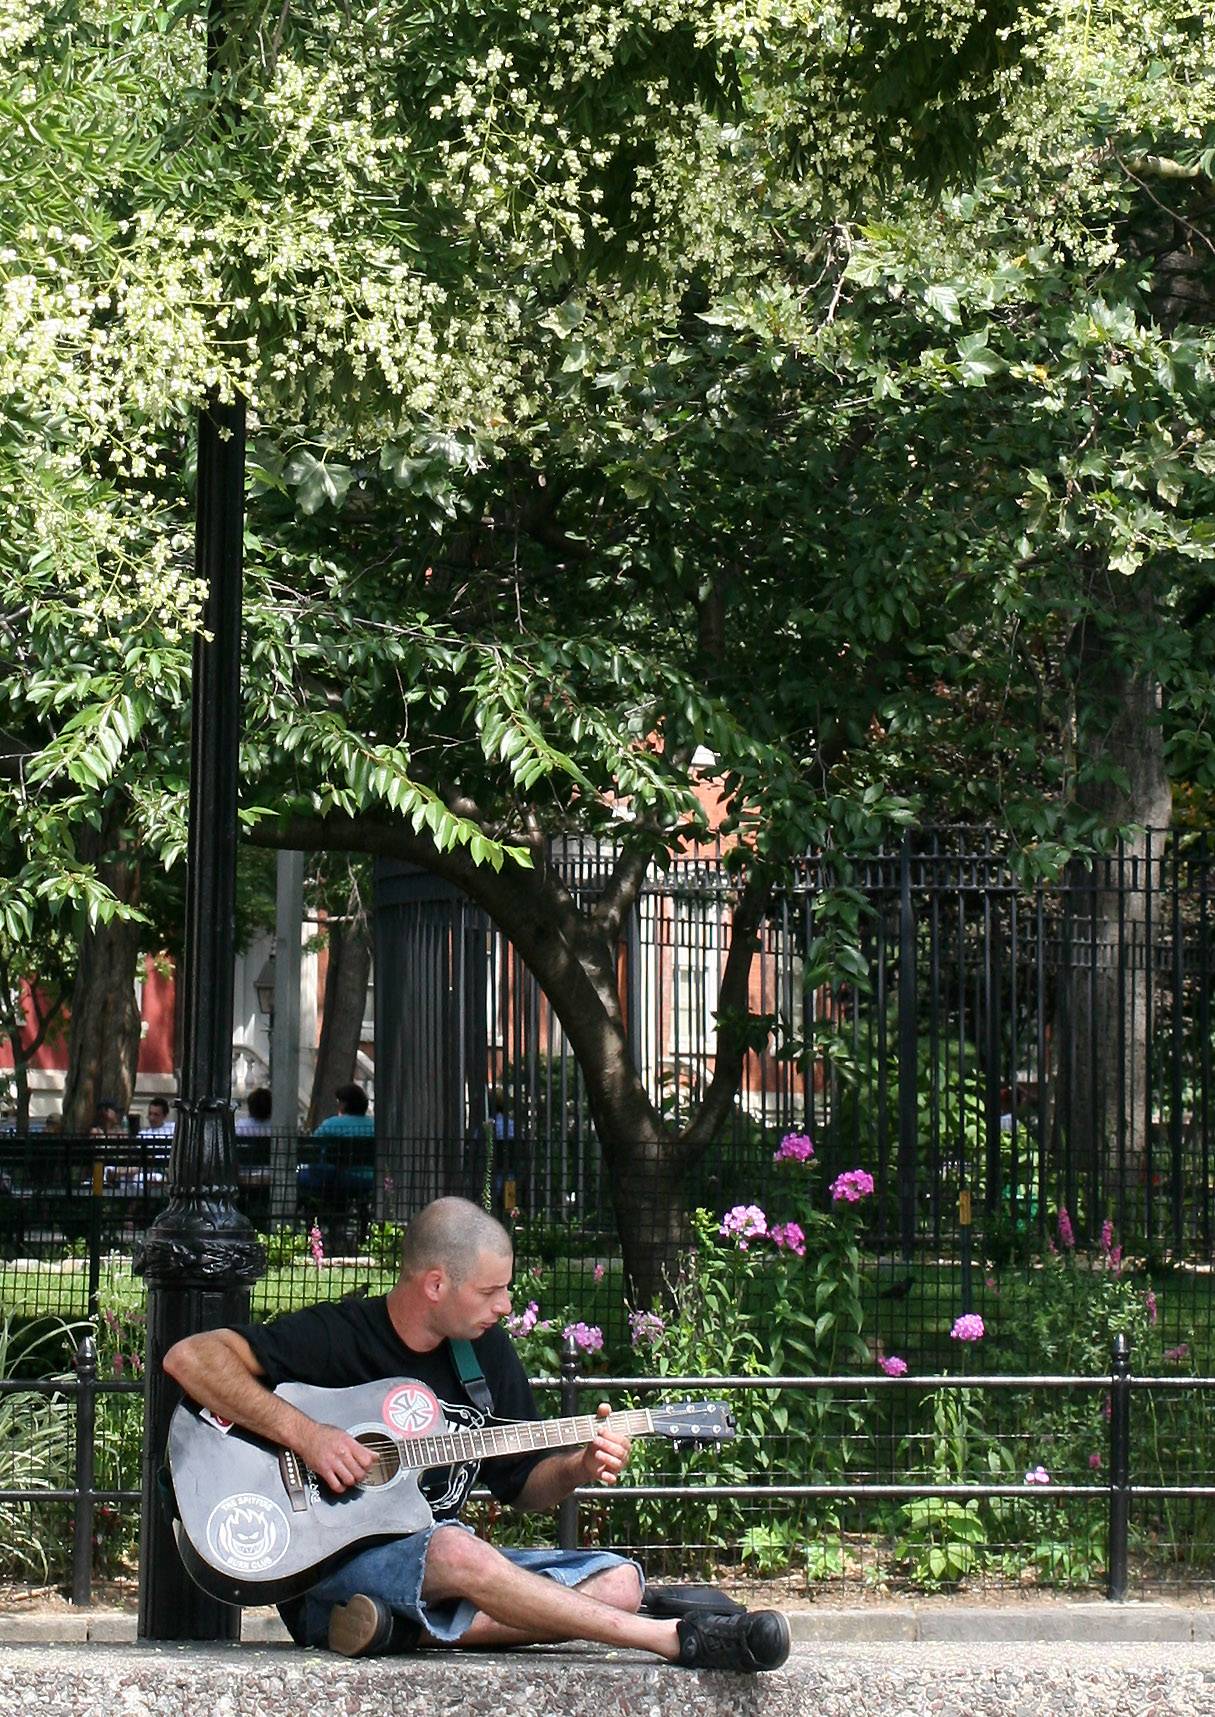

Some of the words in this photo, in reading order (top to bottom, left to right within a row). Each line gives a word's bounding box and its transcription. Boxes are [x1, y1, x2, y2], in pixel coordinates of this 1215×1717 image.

[221, 1500, 238, 1511] THE
[227, 1556, 249, 1569] BURN
[251, 1556, 273, 1569] CLUB
